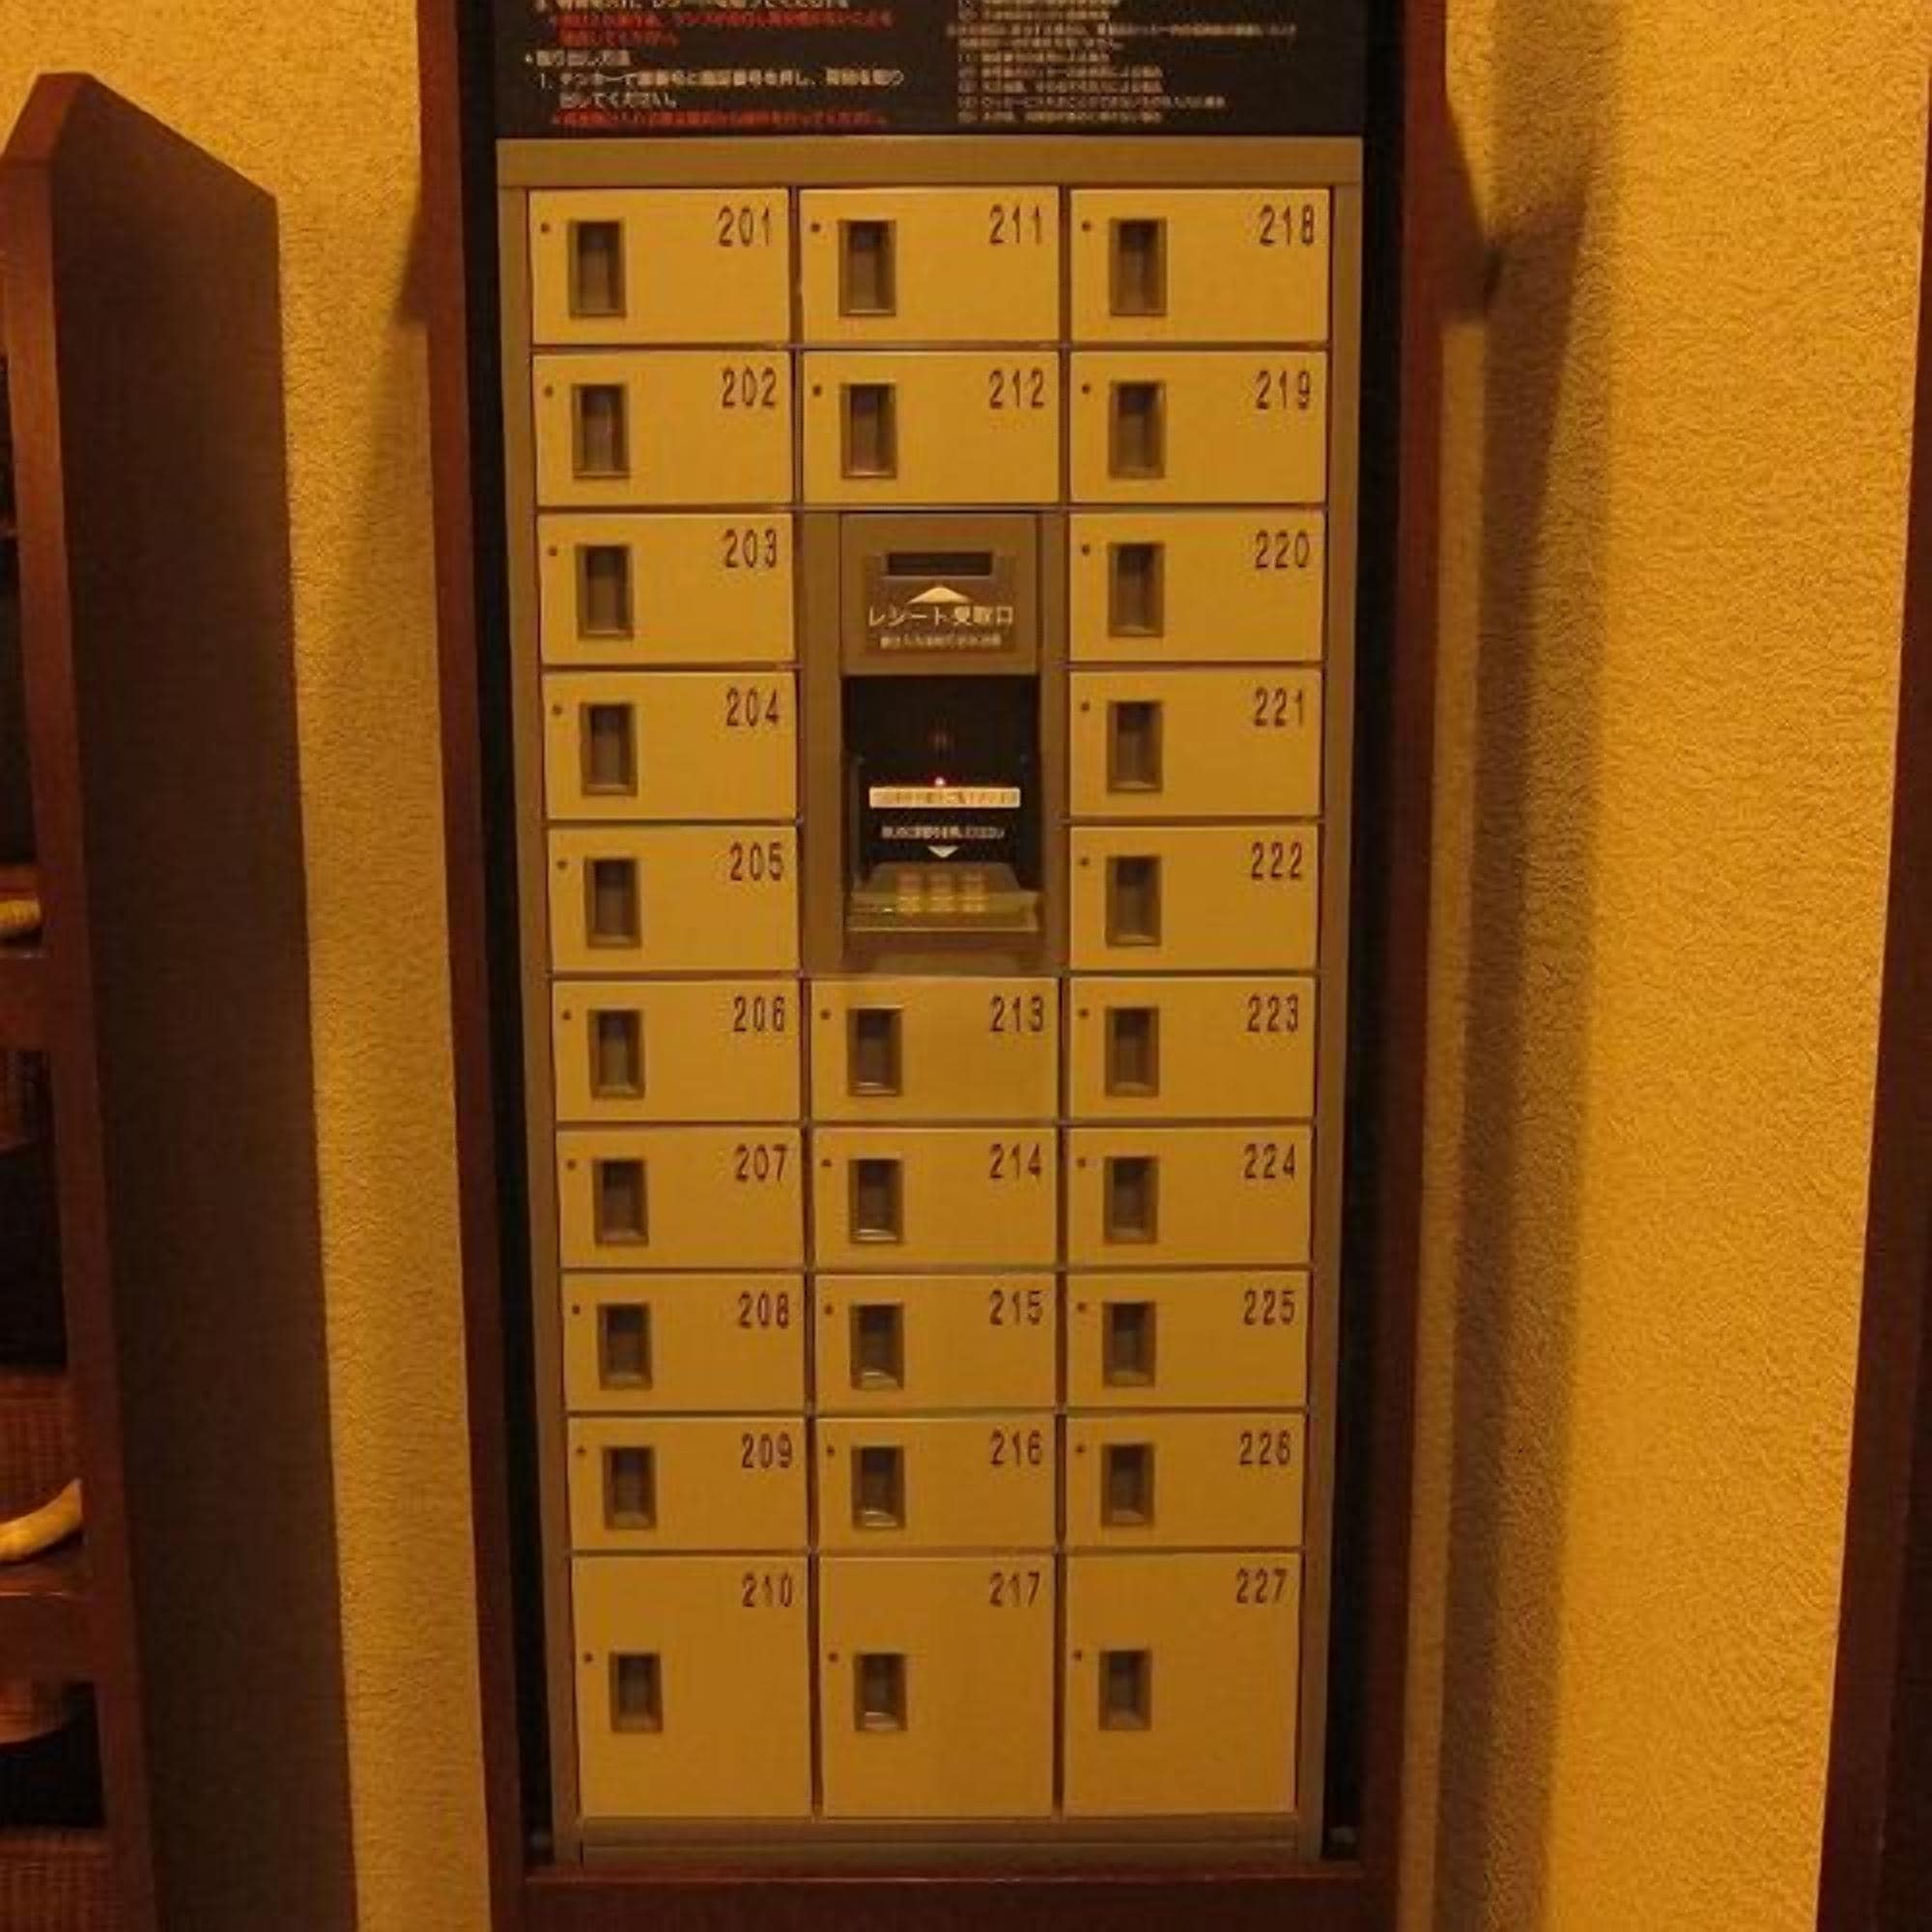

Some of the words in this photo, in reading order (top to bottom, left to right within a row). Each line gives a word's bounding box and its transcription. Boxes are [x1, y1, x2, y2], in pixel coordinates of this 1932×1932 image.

[718, 205, 770, 248] 201
[989, 204, 1041, 246] 211
[1259, 204, 1315, 247] 218
[722, 366, 777, 410] 202
[989, 367, 1045, 411] 212
[1256, 369, 1311, 411] 219
[723, 527, 778, 569] 203
[1255, 529, 1310, 570] 220
[725, 687, 780, 728] 204
[1253, 686, 1304, 728] 221
[729, 841, 784, 882] 205
[1250, 840, 1303, 881] 222
[732, 995, 785, 1034] 206
[989, 994, 1044, 1034] 213
[1246, 993, 1299, 1034] 223
[734, 1143, 788, 1183] 207
[989, 1143, 1042, 1180] 214
[1243, 1143, 1295, 1180] 224
[738, 1291, 790, 1330] 208
[989, 1289, 1043, 1326] 215
[1243, 1288, 1295, 1326] 225
[741, 1432, 793, 1469] 209
[989, 1430, 1042, 1467] 216
[1238, 1430, 1292, 1467] 226
[742, 1572, 793, 1608] 210
[989, 1570, 1040, 1608] 217
[1236, 1567, 1288, 1605] 227
